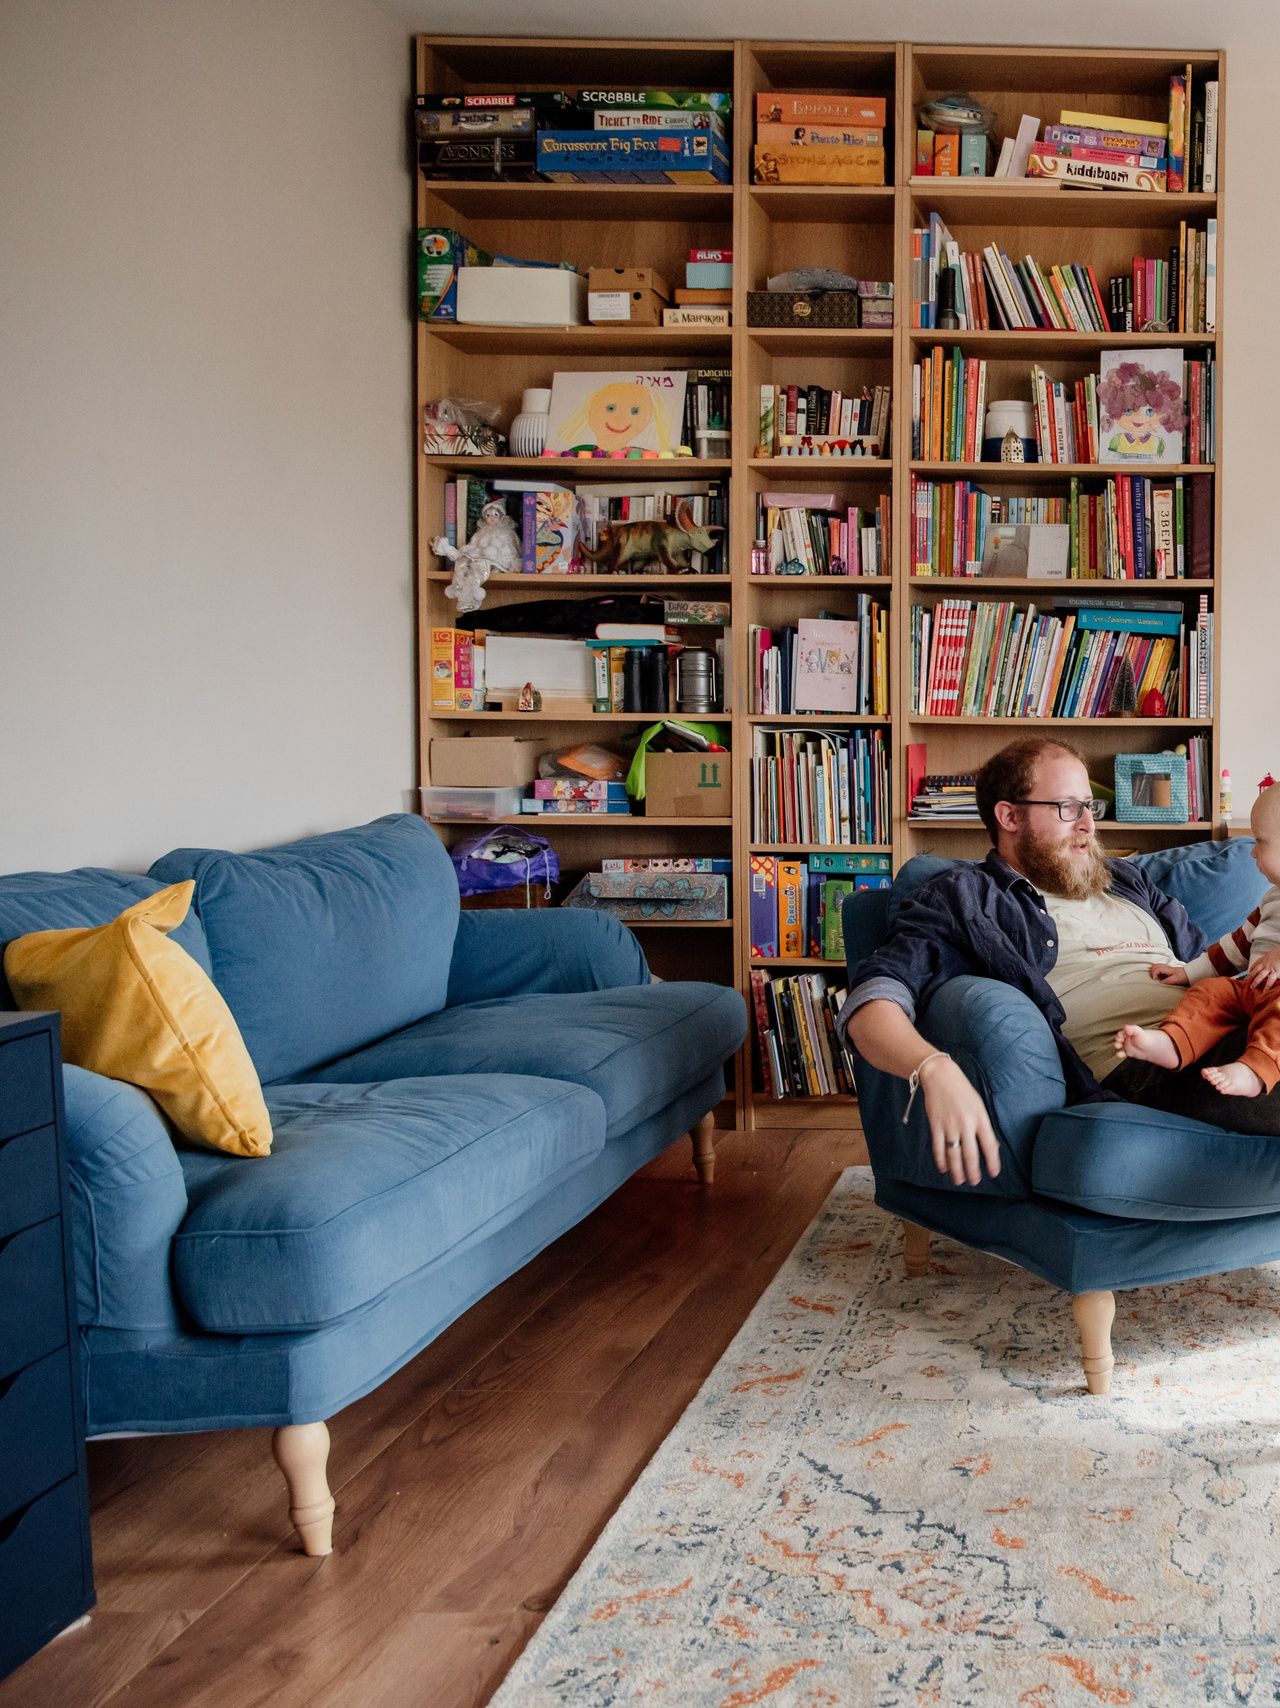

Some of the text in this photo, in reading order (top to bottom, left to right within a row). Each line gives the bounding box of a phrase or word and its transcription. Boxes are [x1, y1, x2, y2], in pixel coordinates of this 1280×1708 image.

[467, 97, 514, 106] SCRABBLE
[582, 92, 646, 104] SCRABBLE
[598, 114, 631, 127] TICKET
[642, 114, 663, 126] RIDE
[842, 132, 864, 146] Rico
[609, 137, 631, 154] Big
[632, 137, 657, 151] Box
[444, 146, 515, 158] WONDRS
[778, 154, 827, 166] STONE
[835, 154, 866, 167] AGE
[1125, 155, 1136, 166] 4
[1066, 163, 1129, 183] kiddiboom
[697, 250, 722, 261] ALIAS
[681, 313, 725, 325] Манчкин
[636, 375, 675, 388] מאיה
[1068, 599, 1104, 607] человека
[1106, 600, 1125, 608] Тело
[434, 632, 451, 642] IQ
